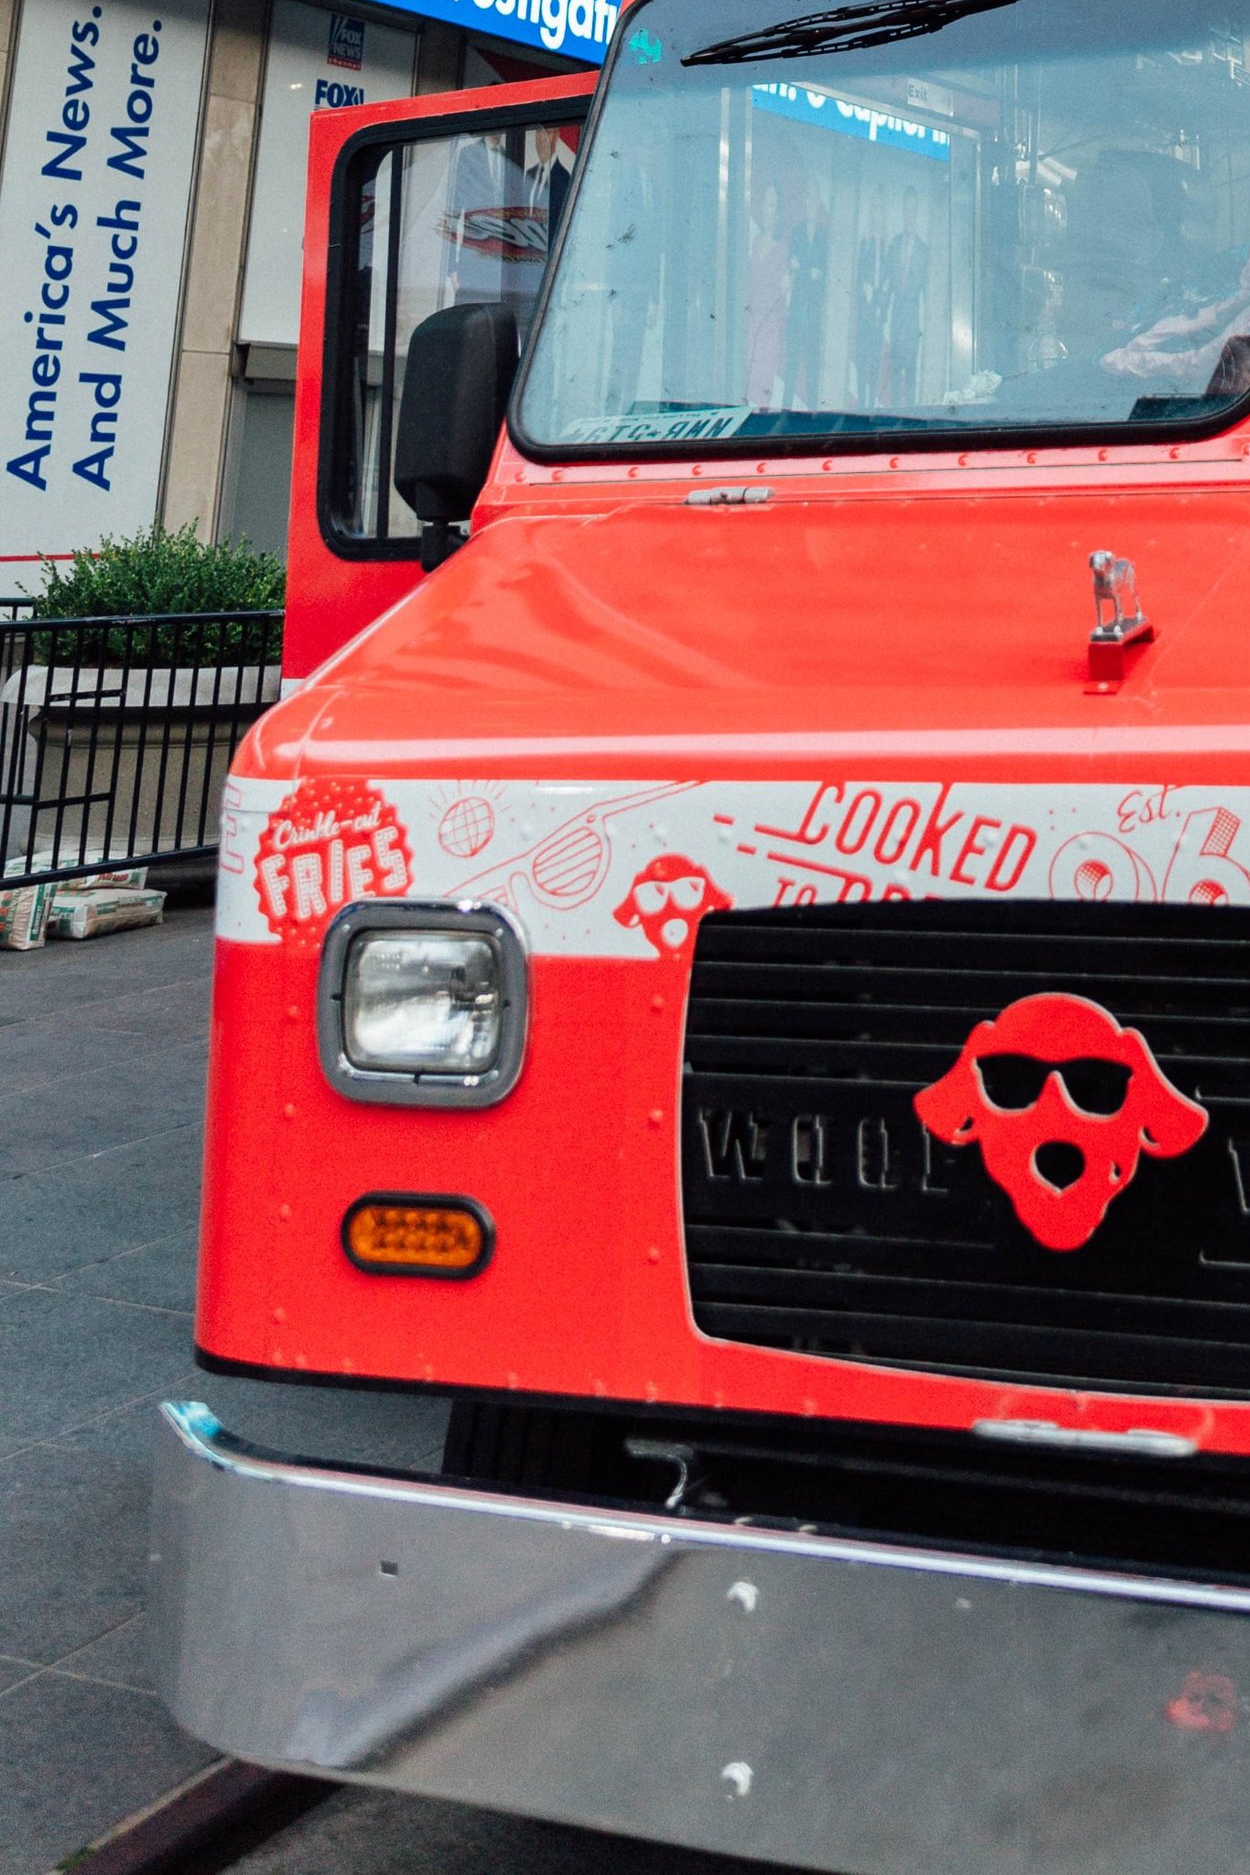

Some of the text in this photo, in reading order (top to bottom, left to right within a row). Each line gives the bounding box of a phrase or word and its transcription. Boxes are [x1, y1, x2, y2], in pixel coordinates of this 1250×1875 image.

[332, 43, 361, 60] NEWS
[340, 28, 363, 44] FOX
[908, 84, 929, 101] Exit
[6, 5, 103, 492] America's News.
[72, 19, 163, 492] And Much More.
[260, 825, 408, 920] FRIES
[800, 782, 1038, 892] COOKED
